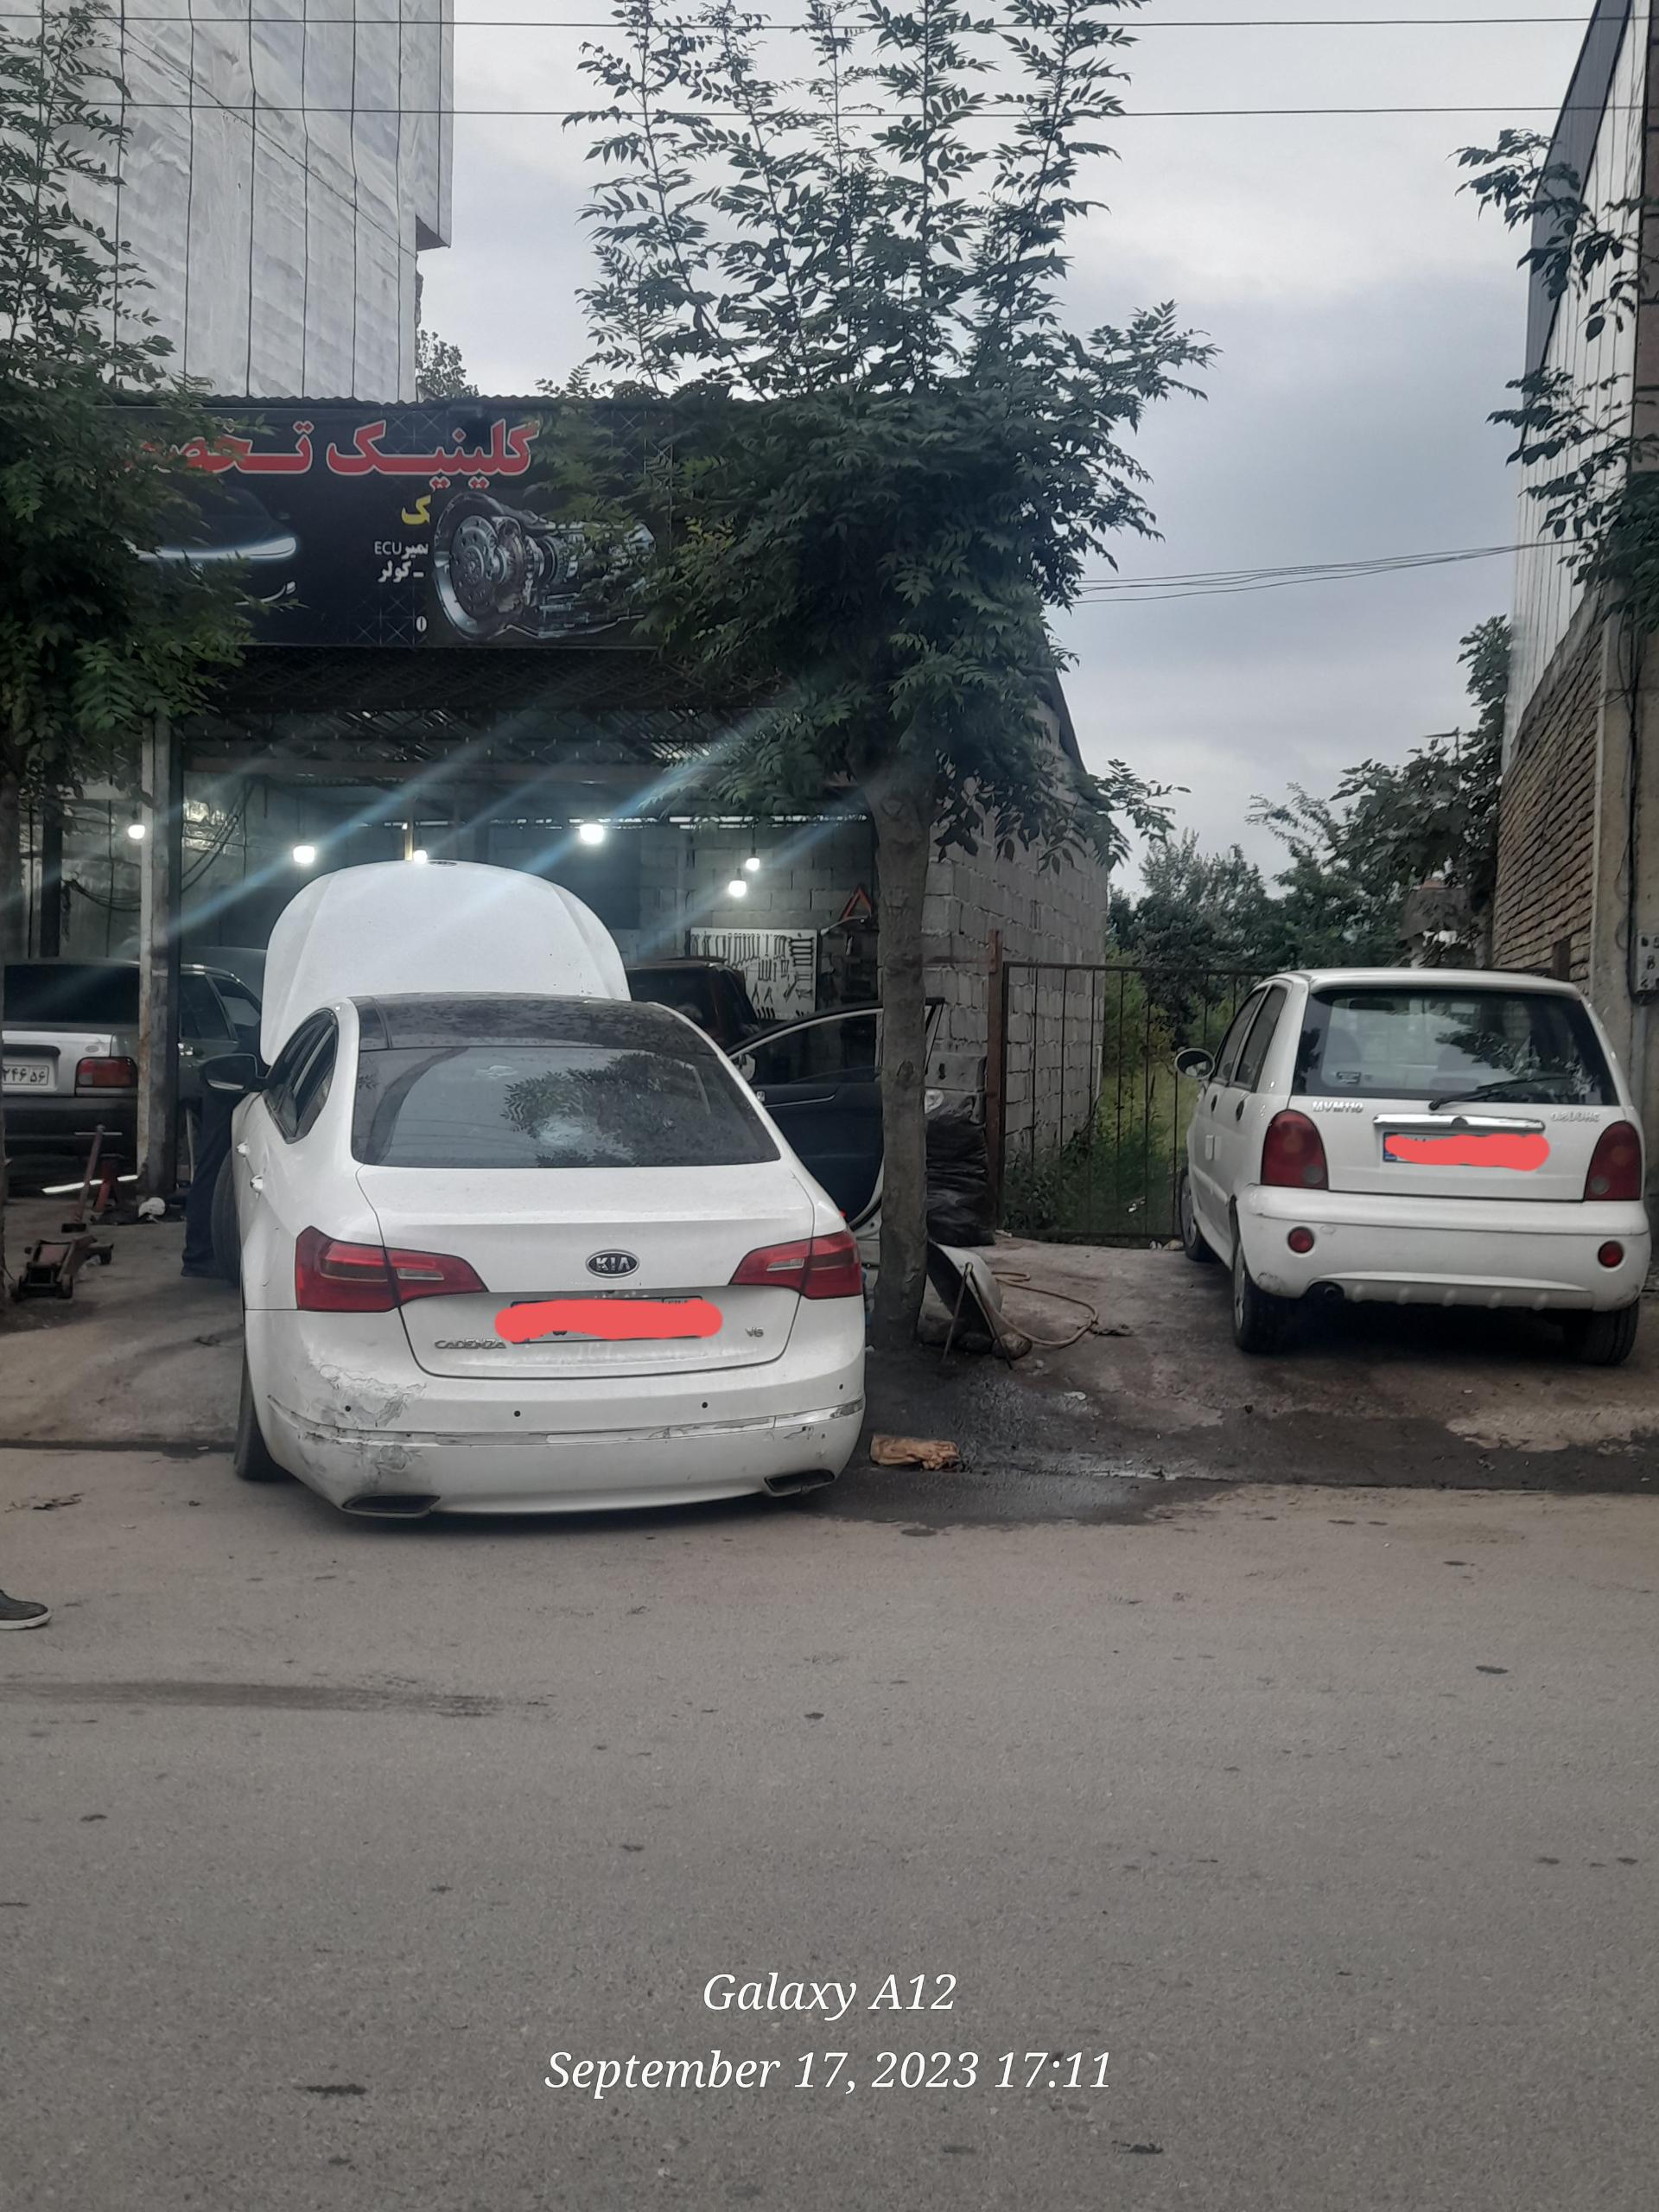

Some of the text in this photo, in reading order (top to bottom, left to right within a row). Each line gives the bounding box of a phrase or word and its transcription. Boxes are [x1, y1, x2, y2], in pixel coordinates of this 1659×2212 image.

[326, 418, 541, 491] کلینیک
[373, 540, 402, 555] ECU
[1313, 1100, 1363, 1113] MVM110
[596, 1256, 631, 1271] KIA
[745, 1326, 764, 1338] V6
[434, 1338, 507, 1349] CADENZA
